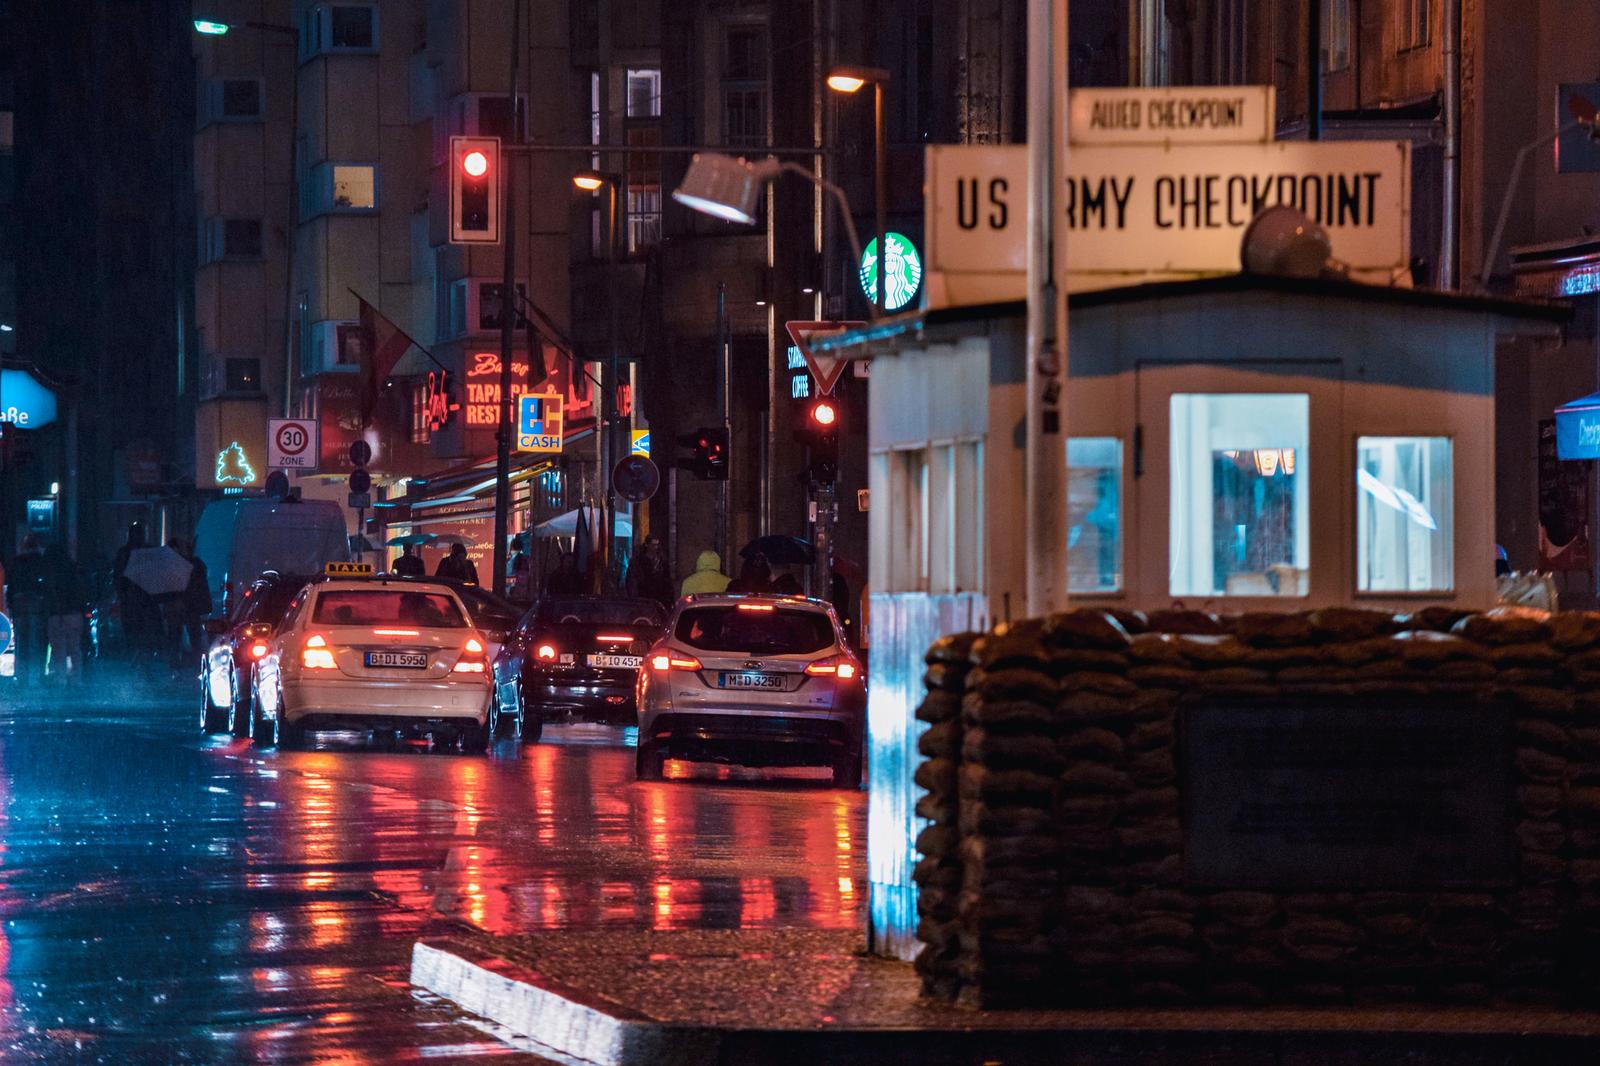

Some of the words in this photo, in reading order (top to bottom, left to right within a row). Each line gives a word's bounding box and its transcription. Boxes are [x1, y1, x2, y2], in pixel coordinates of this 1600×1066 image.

[1090, 99, 1141, 130] ALLIED
[1148, 97, 1247, 130] CHECKPOINT
[957, 177, 1009, 231] US
[792, 375, 809, 398] COFFEE
[283, 431, 302, 446] 30
[520, 436, 560, 448] CASH
[279, 456, 305, 466] ZONE
[335, 564, 366, 573] TAXI
[371, 655, 378, 666] B
[385, 655, 398, 666] DI
[400, 655, 426, 666] 5956
[596, 657, 602, 666] B
[729, 675, 736, 686] M
[744, 675, 751, 686] D
[754, 676, 782, 687] 3250
